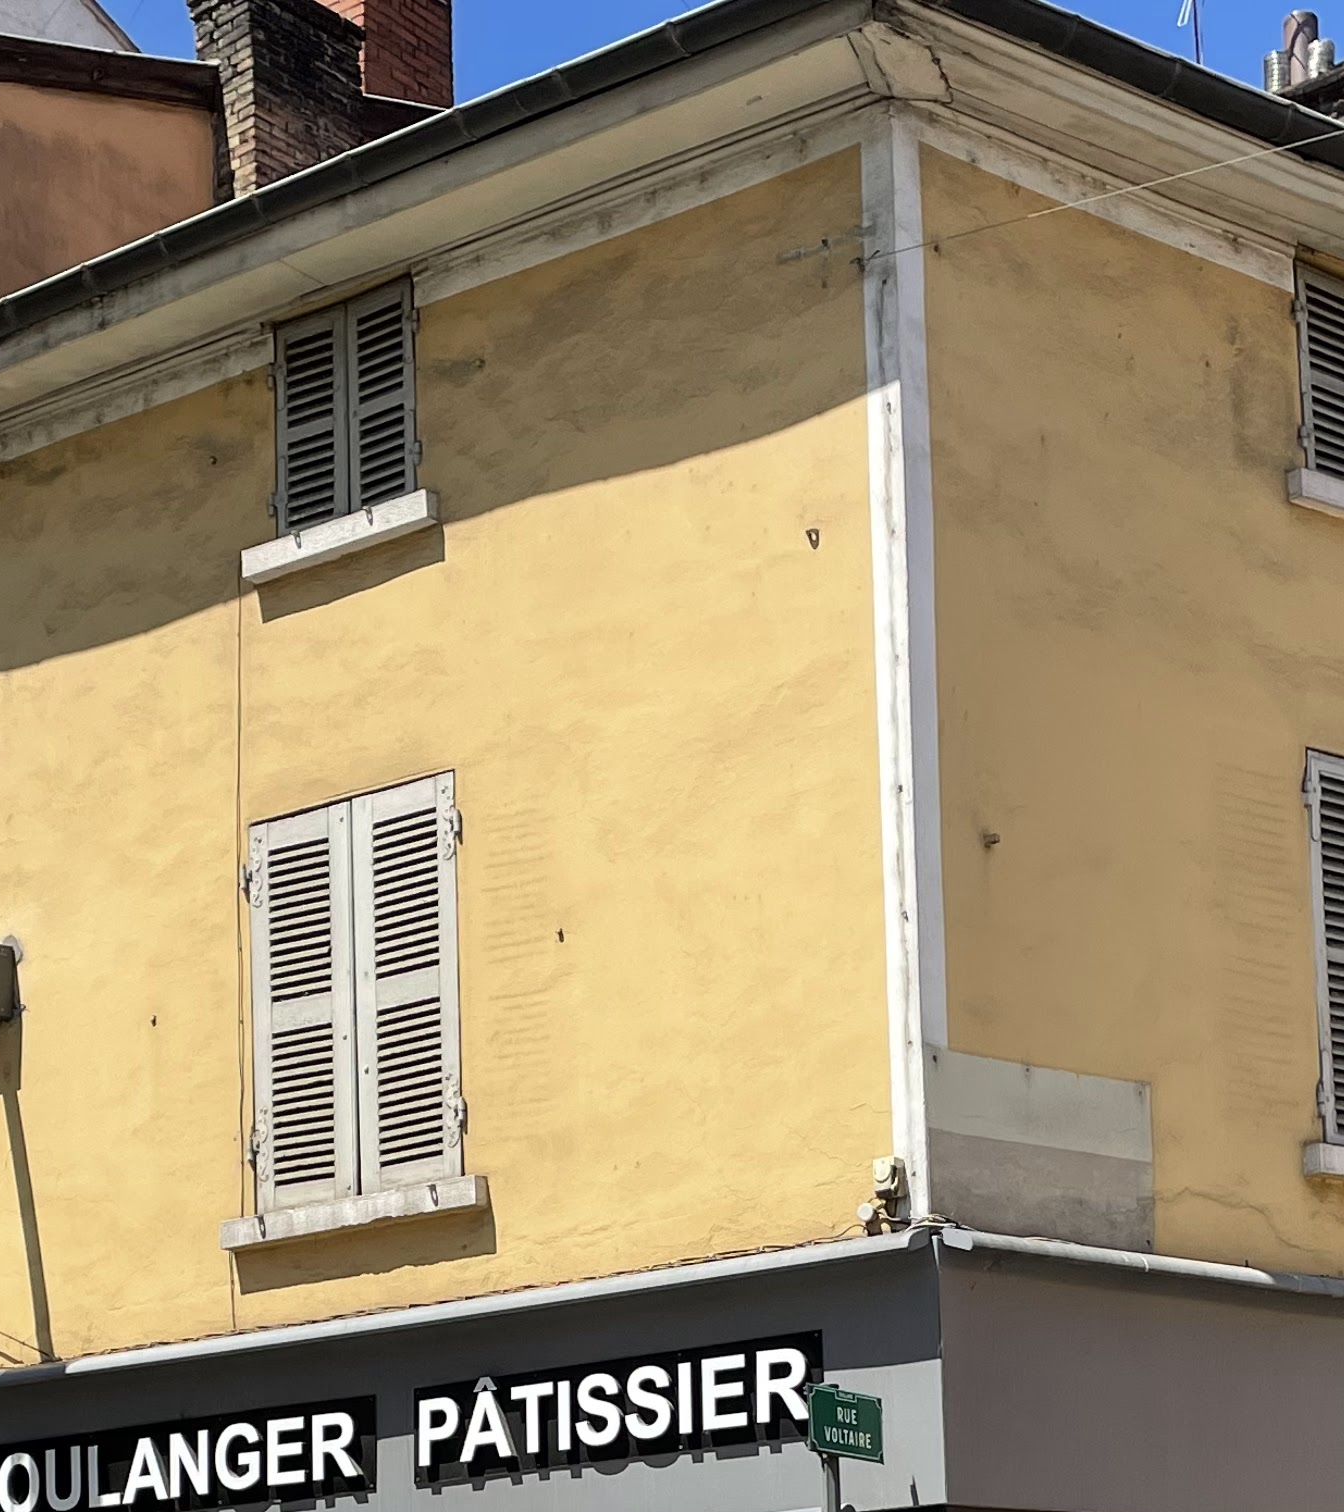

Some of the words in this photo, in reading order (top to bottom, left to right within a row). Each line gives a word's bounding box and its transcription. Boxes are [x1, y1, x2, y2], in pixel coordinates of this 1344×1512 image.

[418, 1347, 809, 1467] PÂTISSIER
[837, 1407, 857, 1424] RUE
[824, 1426, 872, 1449] VOLTAIRE
